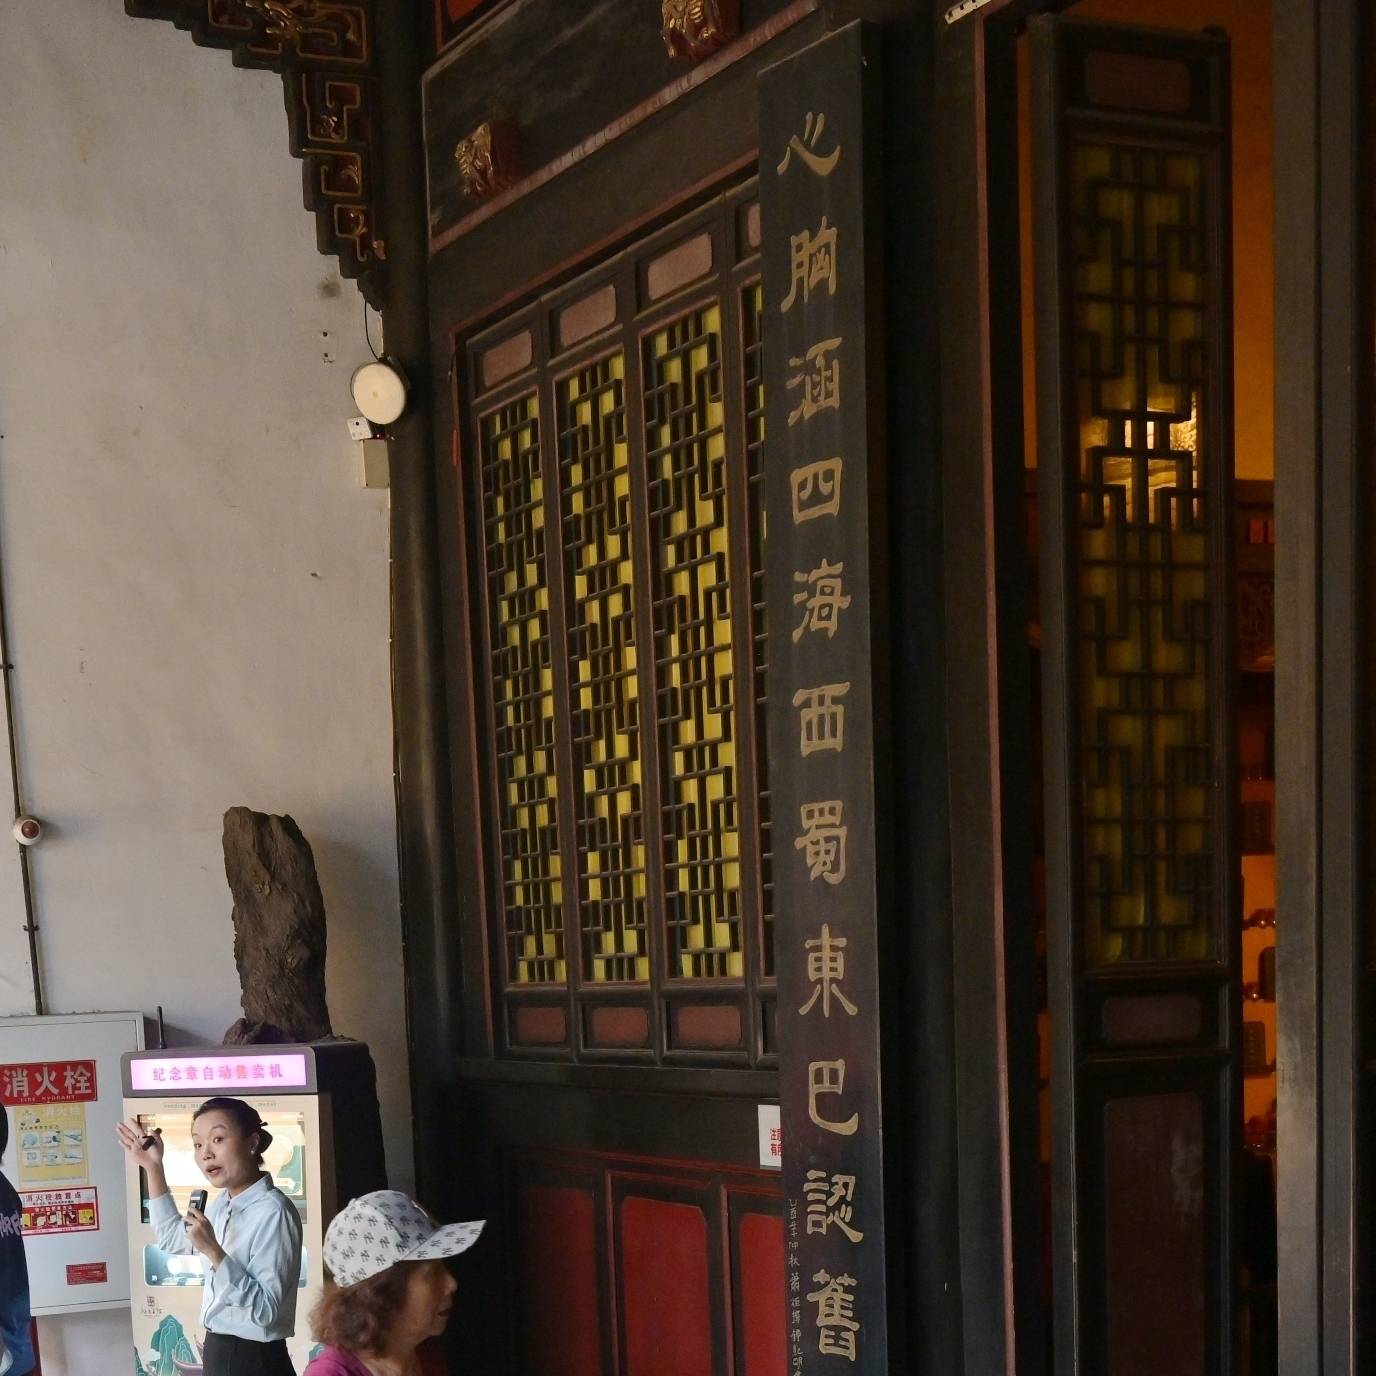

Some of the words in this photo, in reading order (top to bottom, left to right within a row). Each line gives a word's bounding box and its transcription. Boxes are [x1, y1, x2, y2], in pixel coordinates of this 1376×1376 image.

[3, 1064, 92, 1097] 消火栓
[153, 1064, 283, 1082] 纪念章自动售卖机
